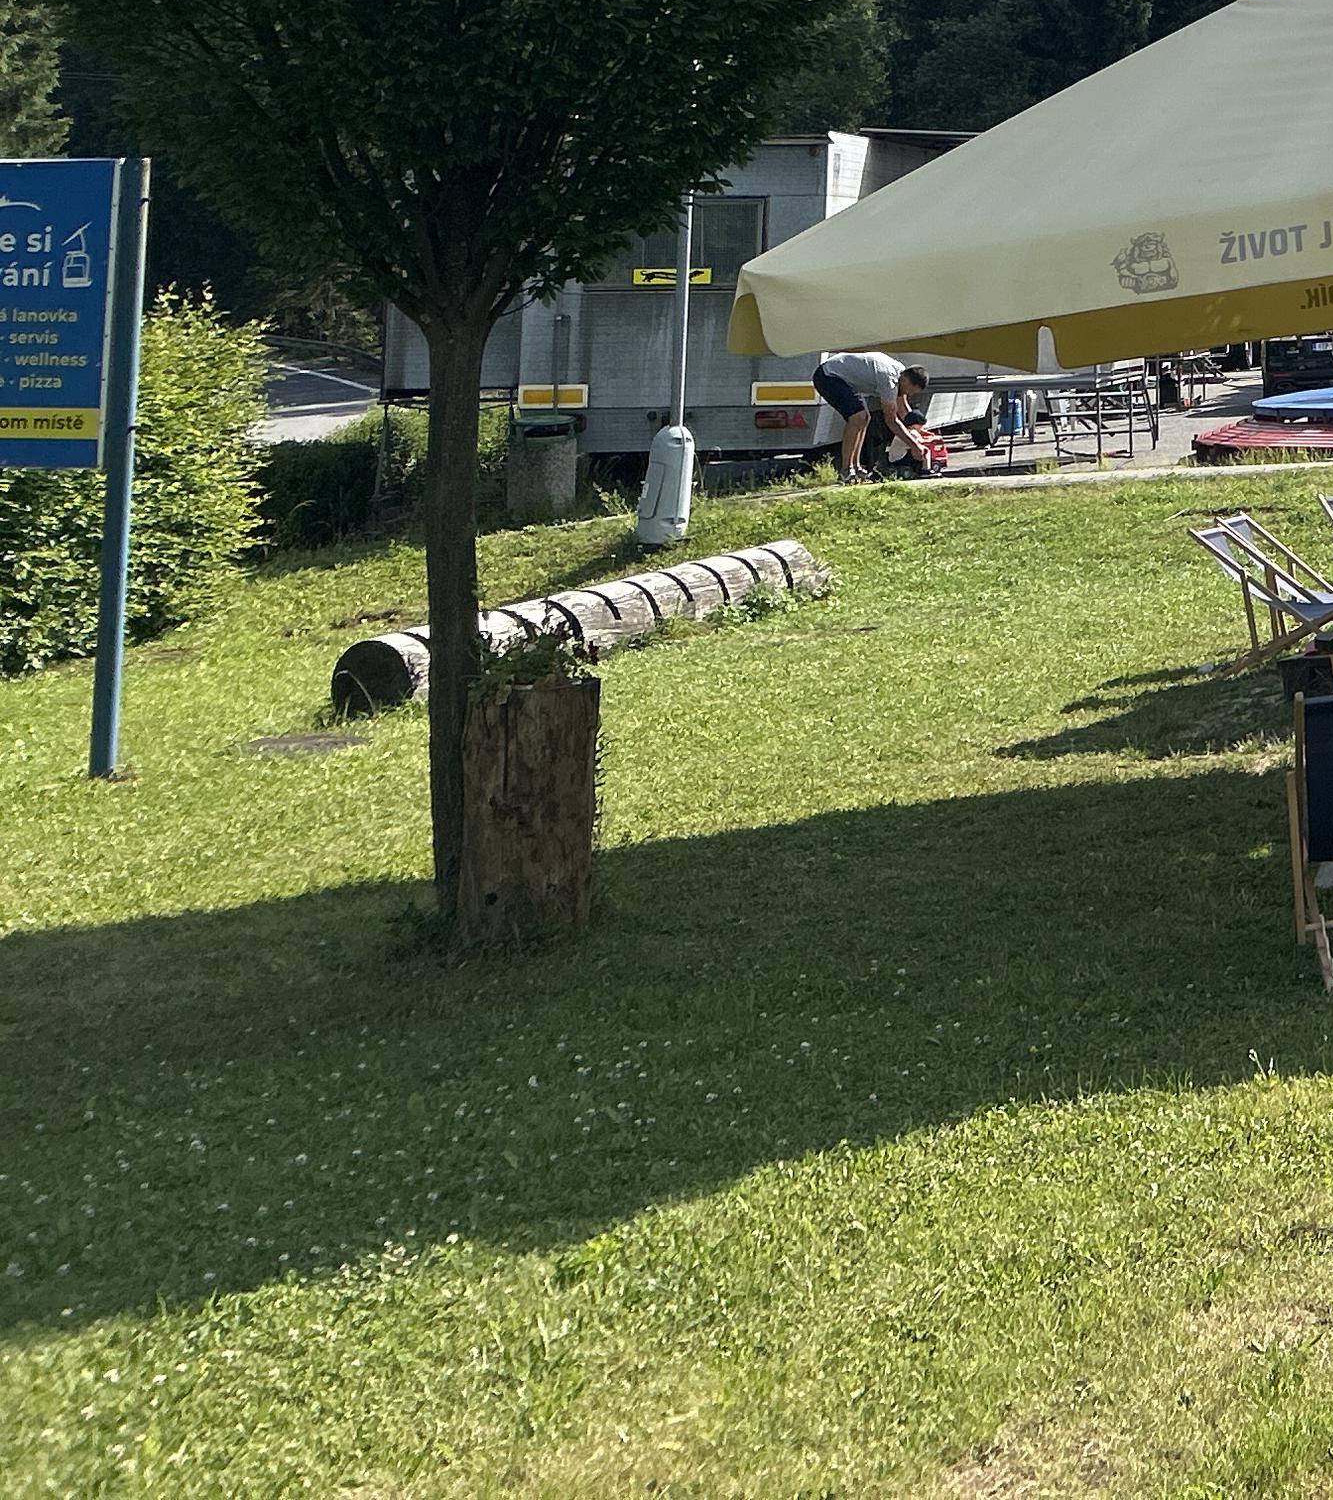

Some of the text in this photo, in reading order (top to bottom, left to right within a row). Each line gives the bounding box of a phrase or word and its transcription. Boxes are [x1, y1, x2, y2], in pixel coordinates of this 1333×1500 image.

[26, 225, 53, 253] si
[1219, 224, 1308, 265] ŽIVOT
[12, 308, 78, 322] lanovka
[8, 329, 59, 345] servis
[14, 352, 88, 368] wellness
[19, 373, 63, 391] pizza
[33, 413, 85, 431] místě
